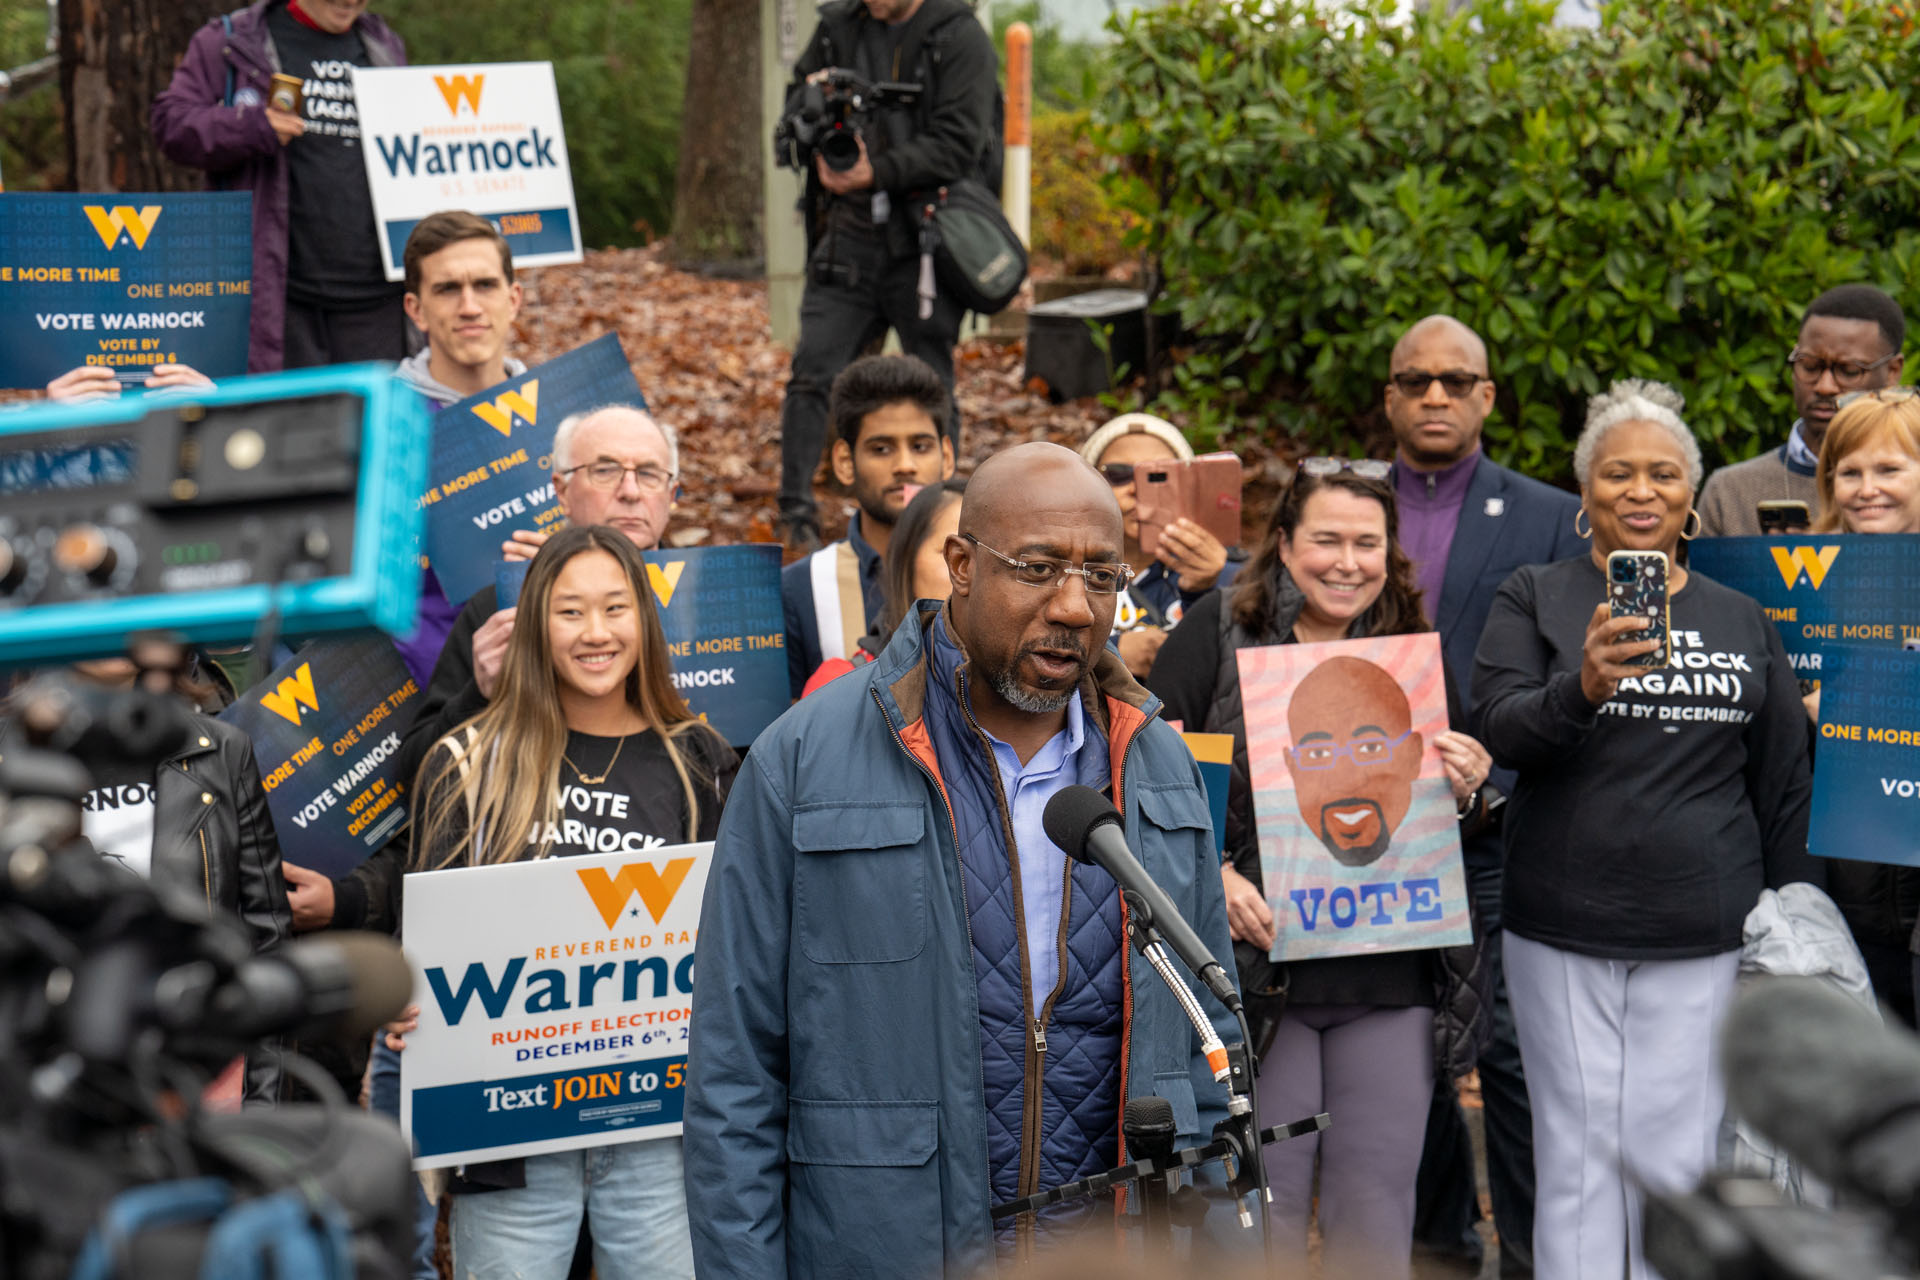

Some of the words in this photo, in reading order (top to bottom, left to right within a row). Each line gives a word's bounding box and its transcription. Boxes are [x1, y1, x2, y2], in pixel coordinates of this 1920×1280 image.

[376, 127, 557, 178] Warnock
[18, 267, 73, 282] MORE
[76, 267, 121, 282] TIME
[127, 283, 164, 299] ONE
[168, 281, 214, 297] MORE
[217, 280, 251, 296] TIME
[35, 313, 95, 331] VOTE
[100, 311, 206, 330] WARNOCK
[99, 338, 137, 351] VOTE
[141, 337, 160, 351] BY
[86, 353, 165, 367] DECEMBER
[168, 352, 177, 364] 6
[442, 466, 490, 498] MORE
[489, 448, 529, 475] TIME
[472, 497, 527, 531] VOTE
[1763, 608, 1798, 622] TIME
[695, 636, 744, 655] MORE
[745, 633, 784, 650] TIME
[1802, 624, 1837, 639] ONE
[1842, 624, 1894, 640] MORE
[1900, 624, 1920, 640] TI
[1613, 673, 1743, 703] AGAIN)
[332, 729, 360, 757] ONE
[356, 705, 393, 737] MORE
[387, 678, 419, 710] TIME
[1632, 704, 1655, 718] BY
[1658, 706, 1746, 723] DECEMBER
[1821, 722, 1862, 741] ONE
[1867, 727, 1920, 747] MORE
[291, 736, 325, 768] TIME
[292, 789, 338, 829] VOTE
[332, 731, 402, 796] WARNOCK
[346, 788, 375, 815] VOTE
[371, 776, 386, 795] BY
[557, 785, 630, 819] VOTE
[347, 788, 399, 836] DECEMBER
[1290, 877, 1443, 932] VOTE
[535, 935, 653, 961] REVEREND
[491, 1021, 583, 1046] RUNOFF
[516, 1034, 634, 1062] DECEMBER
[484, 1083, 548, 1112] Text
[553, 1071, 623, 1110] JOIN
[628, 1071, 659, 1093] to
